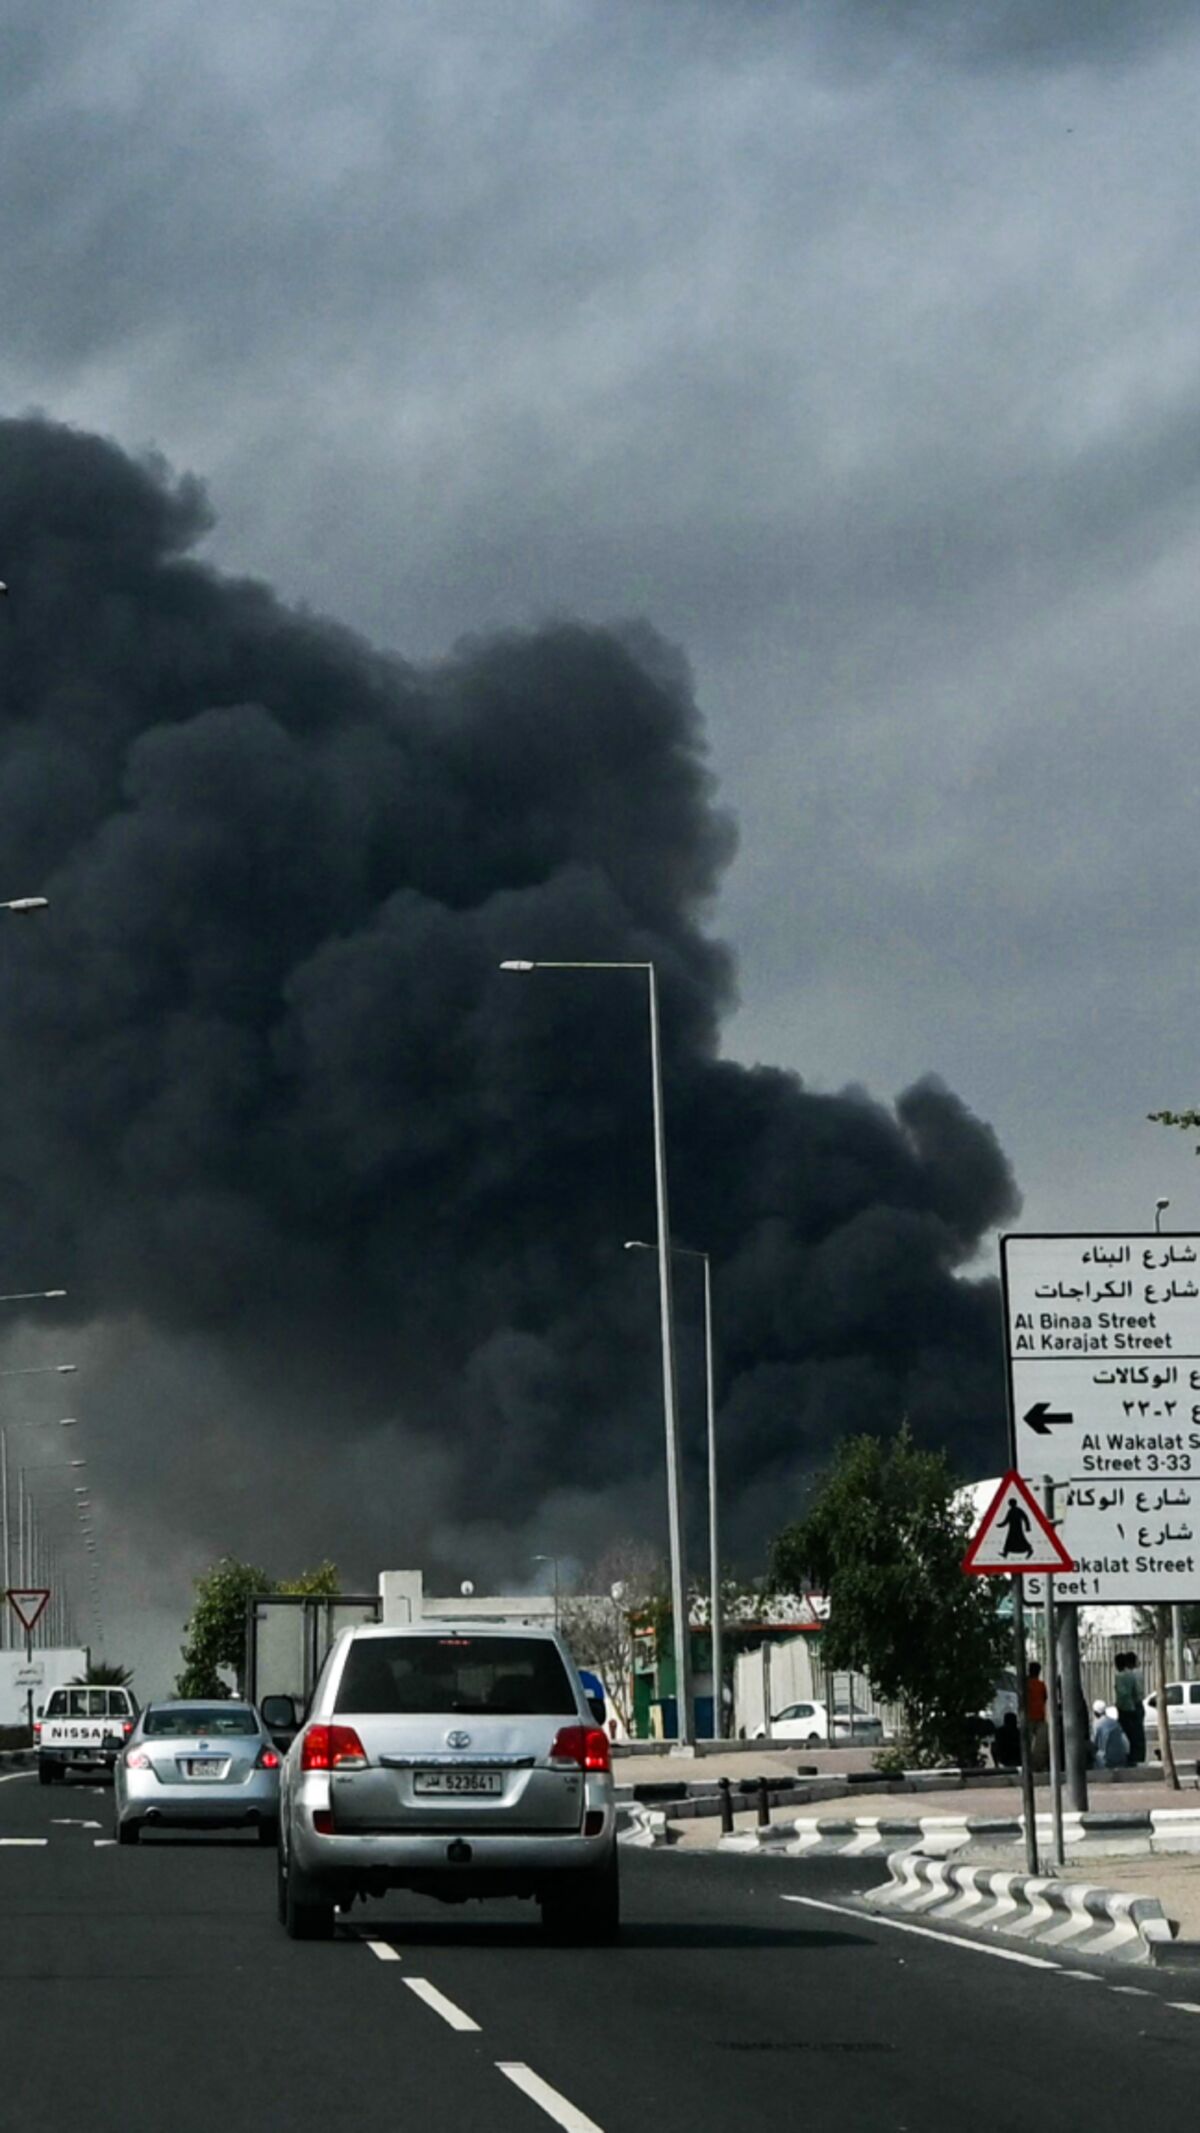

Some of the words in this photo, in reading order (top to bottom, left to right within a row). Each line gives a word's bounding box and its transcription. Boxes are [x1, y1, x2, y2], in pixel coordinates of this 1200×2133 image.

[1082, 1246, 1131, 1267] البناء
[1143, 1246, 1197, 1269] شارع
[1034, 1281, 1132, 1302] الكراجات
[1144, 1281, 1199, 1304] شارع
[1014, 1313, 1033, 1329] Al
[1040, 1313, 1092, 1329] Binaa
[1098, 1312, 1156, 1329] Street
[1016, 1334, 1035, 1350] Al
[1041, 1333, 1107, 1352] Karajat
[1114, 1333, 1172, 1349] Street
[1093, 1366, 1177, 1388] الوكالات
[1081, 1434, 1101, 1450] Al
[1107, 1434, 1183, 1450] Wakalat
[1083, 1455, 1142, 1471] Street
[1147, 1454, 1192, 1471] 3-33
[1135, 1488, 1191, 1513] شارع
[1137, 1523, 1193, 1548] شارع
[1072, 1557, 1129, 1573] akalat
[1135, 1556, 1194, 1573] Street
[1093, 1577, 1099, 1593] 1
